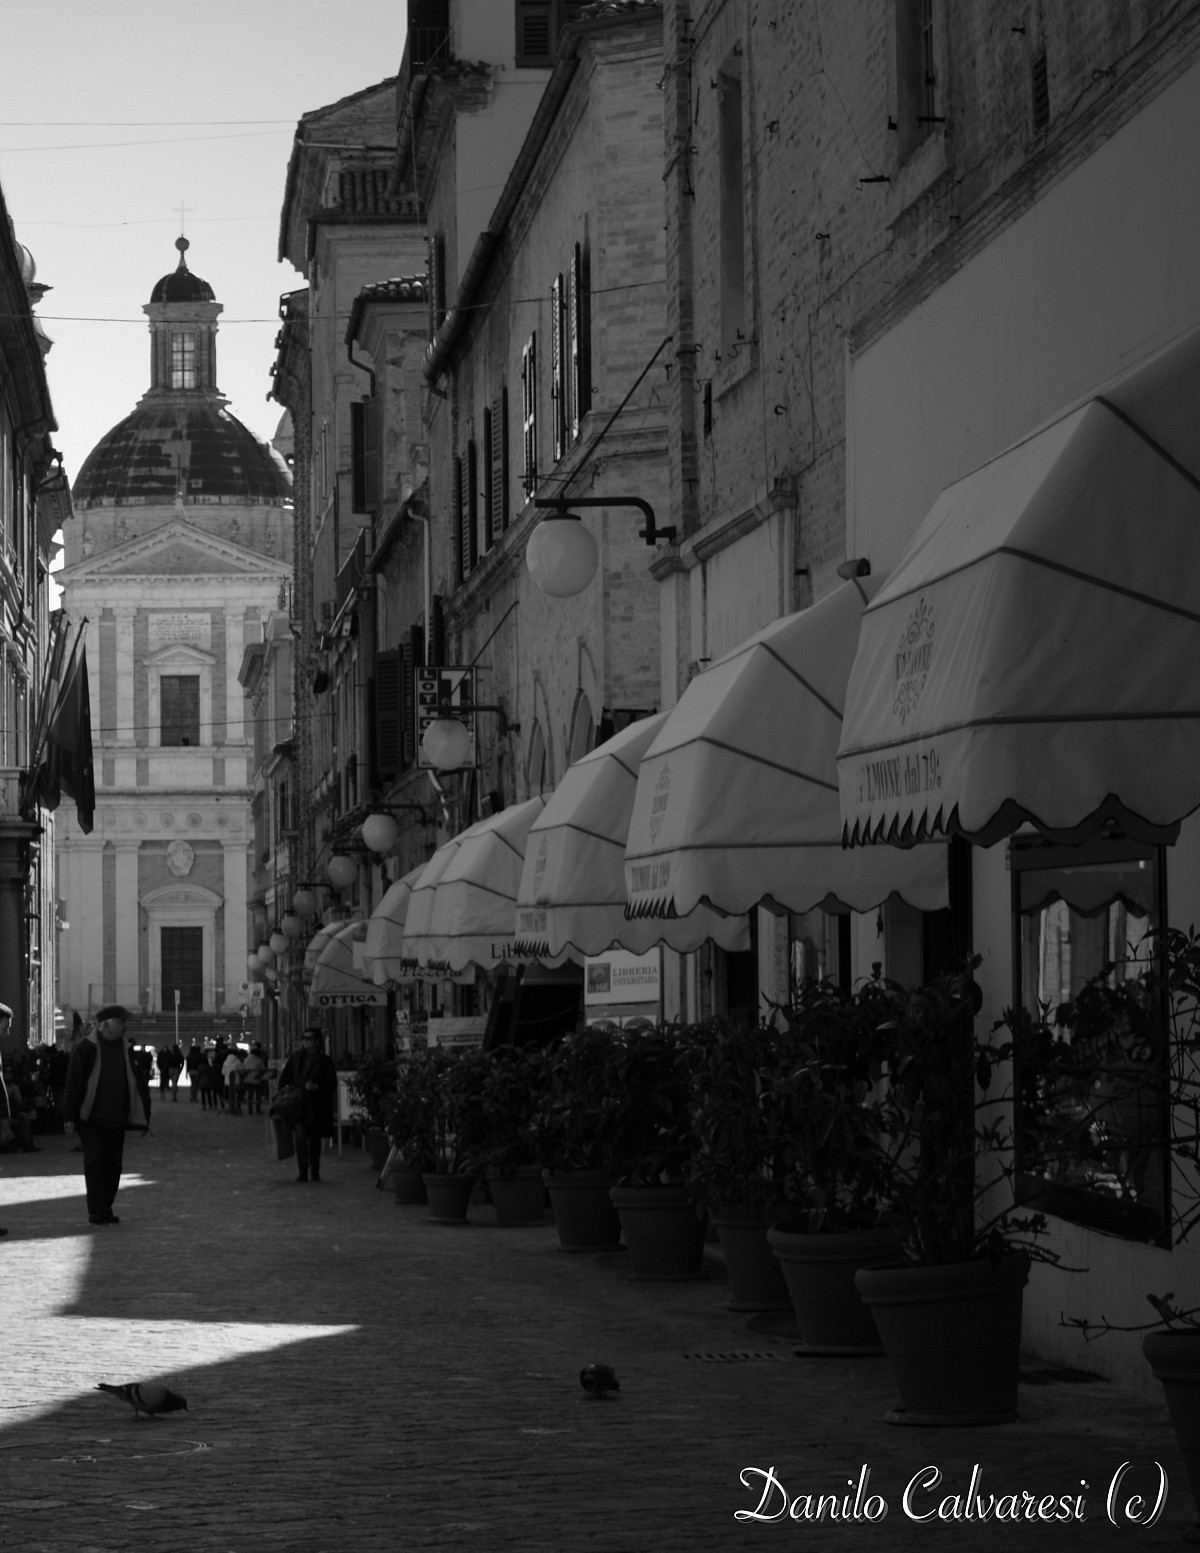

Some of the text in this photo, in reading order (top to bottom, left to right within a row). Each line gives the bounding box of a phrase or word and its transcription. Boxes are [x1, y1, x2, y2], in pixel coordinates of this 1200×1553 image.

[905, 752, 920, 795] dal
[613, 966, 658, 977] LIBRERIA
[613, 976, 658, 987] UNIVERSITARIA
[319, 995, 377, 1005] OTTICA
